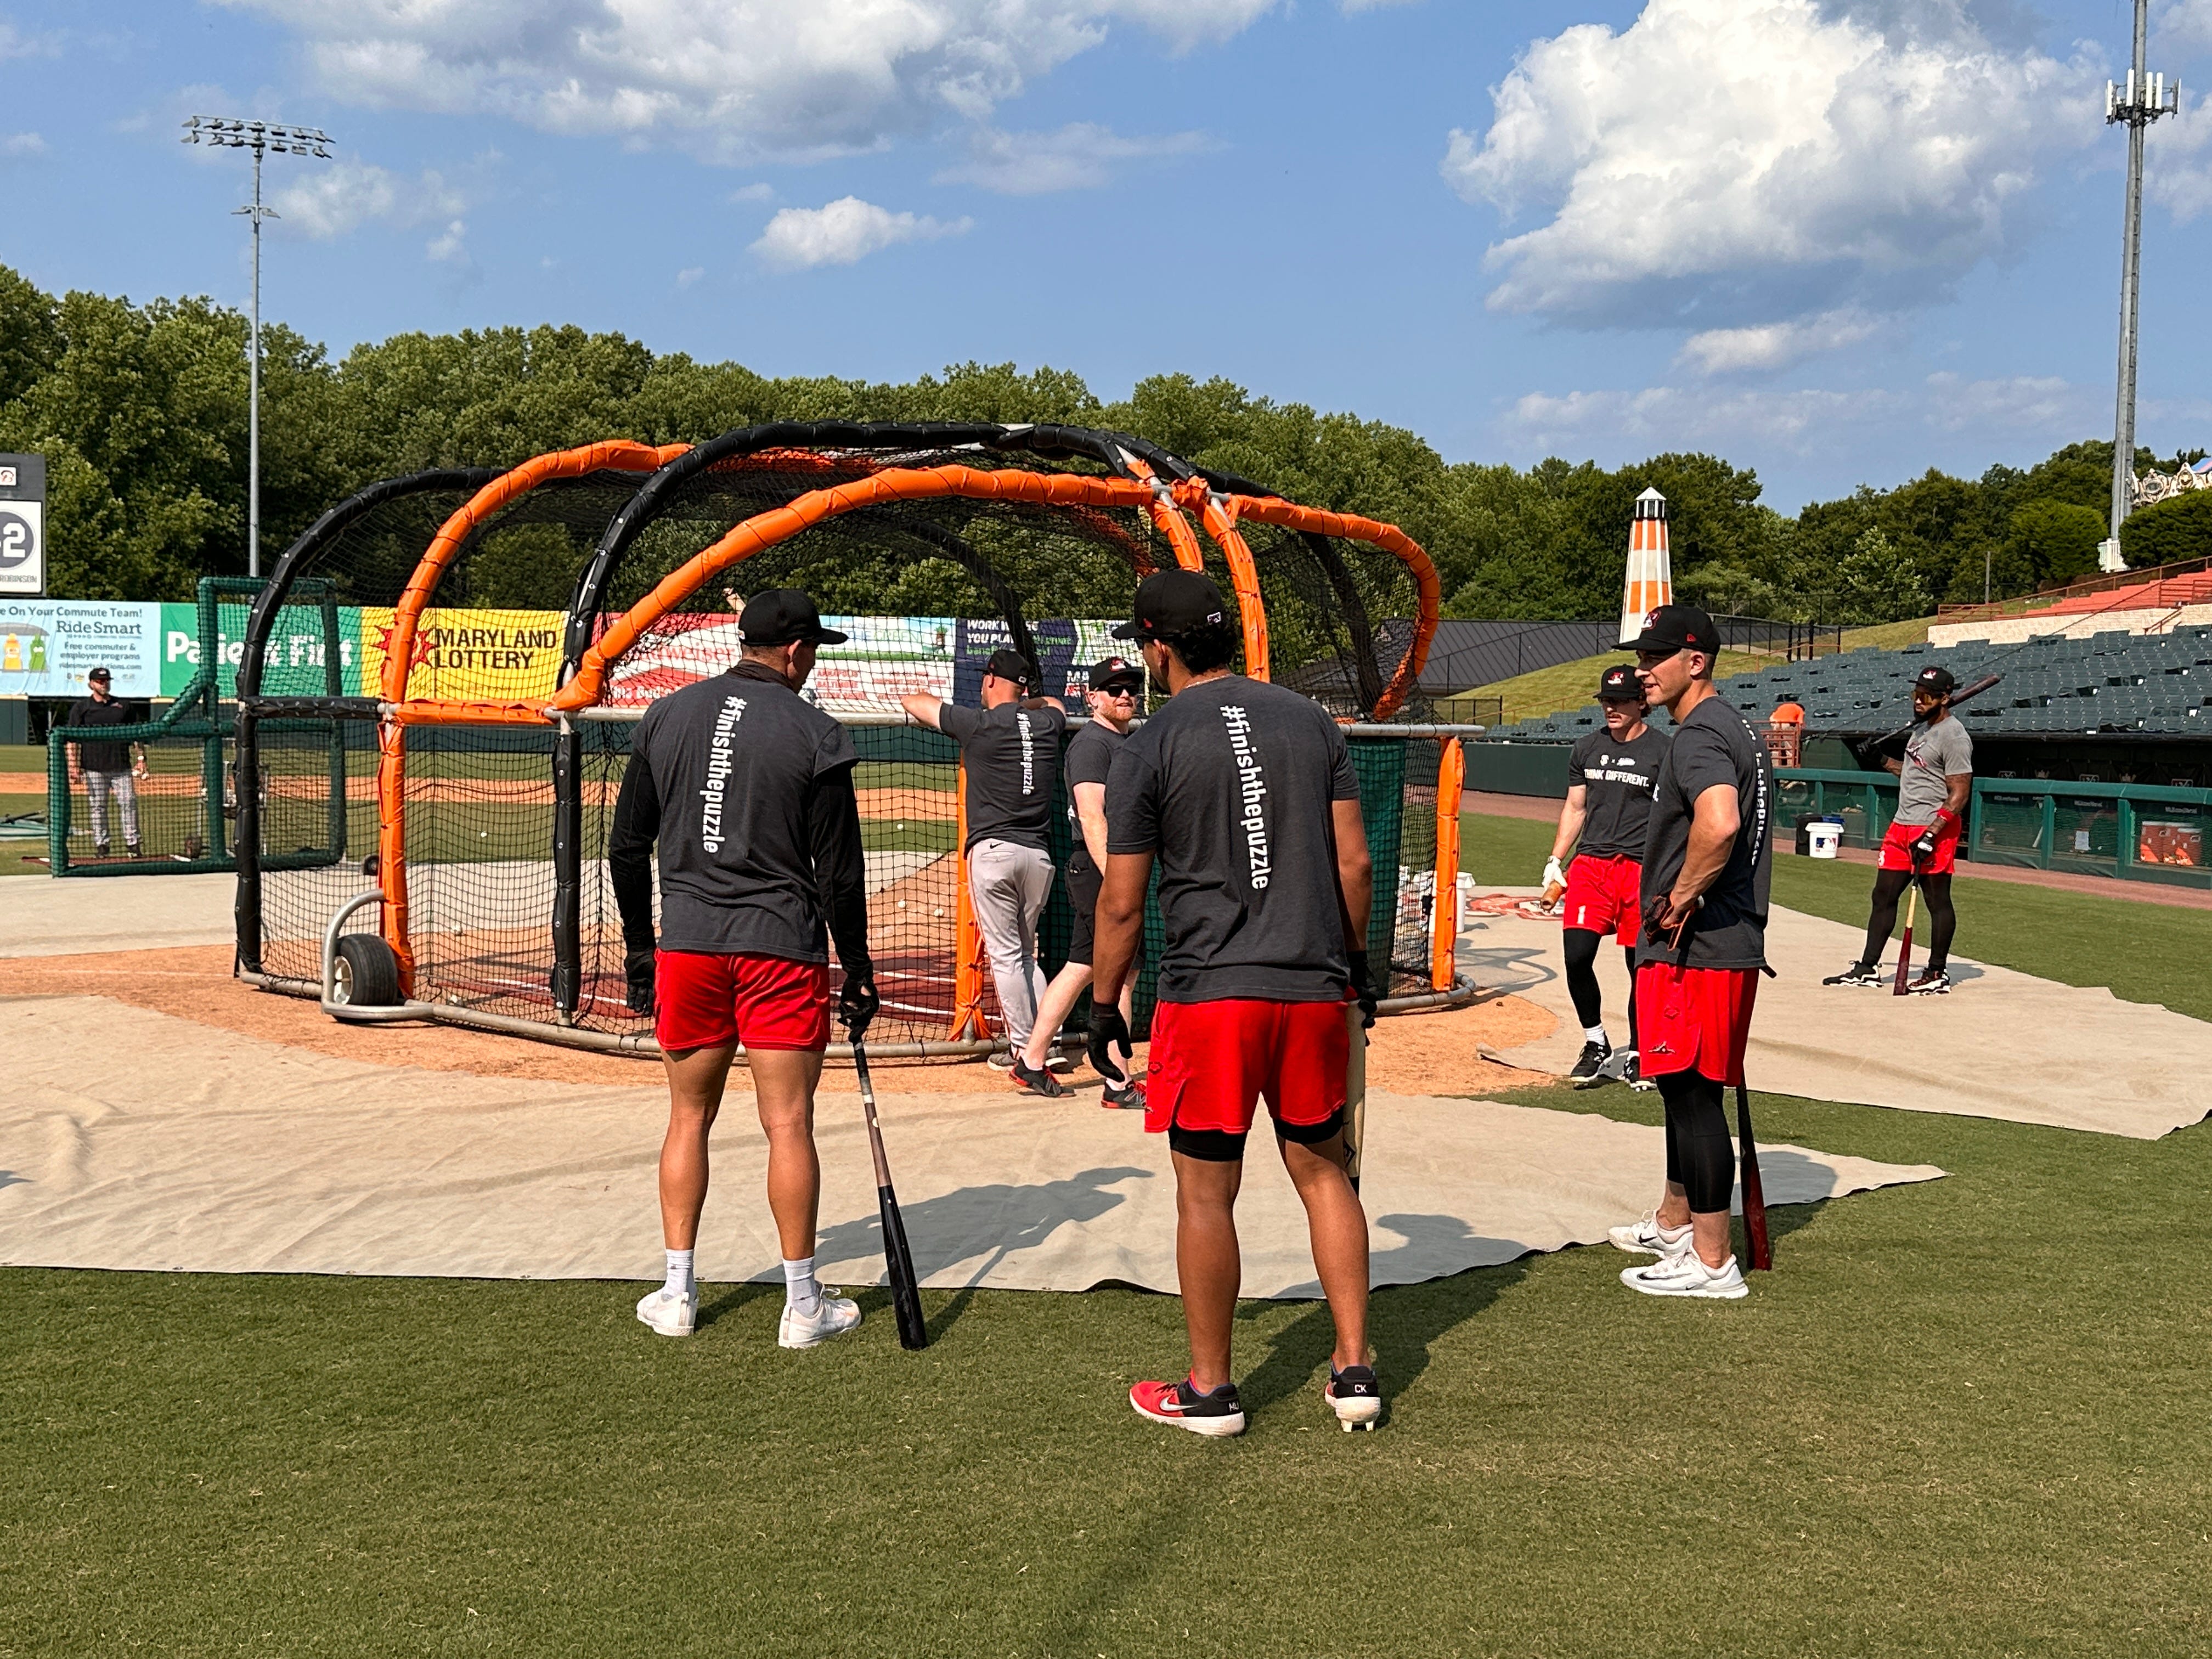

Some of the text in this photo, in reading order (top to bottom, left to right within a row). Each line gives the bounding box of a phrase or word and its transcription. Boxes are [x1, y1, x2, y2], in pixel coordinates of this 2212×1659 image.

[9, 606, 25, 616] On
[28, 607, 54, 616] Your
[57, 607, 108, 617] Commute
[110, 608, 142, 618] Team!
[967, 619, 1000, 630] WORK
[436, 628, 556, 648] MARYLAND
[846, 631, 872, 641] THE
[967, 633, 988, 644] YOU
[64, 641, 82, 650] Free
[167, 631, 352, 667] Paiet Firt
[60, 652, 140, 661] employer programs
[437, 650, 534, 669] LOTTERY
[1017, 713, 1035, 795] #finishthepuzzle
[699, 695, 747, 854] #finishthepuzzle
[1584, 769, 1649, 787] THINK DIFFERENT.
[1220, 705, 1272, 889] #finishthepuzzle
[1355, 1384, 1368, 1393] CK
